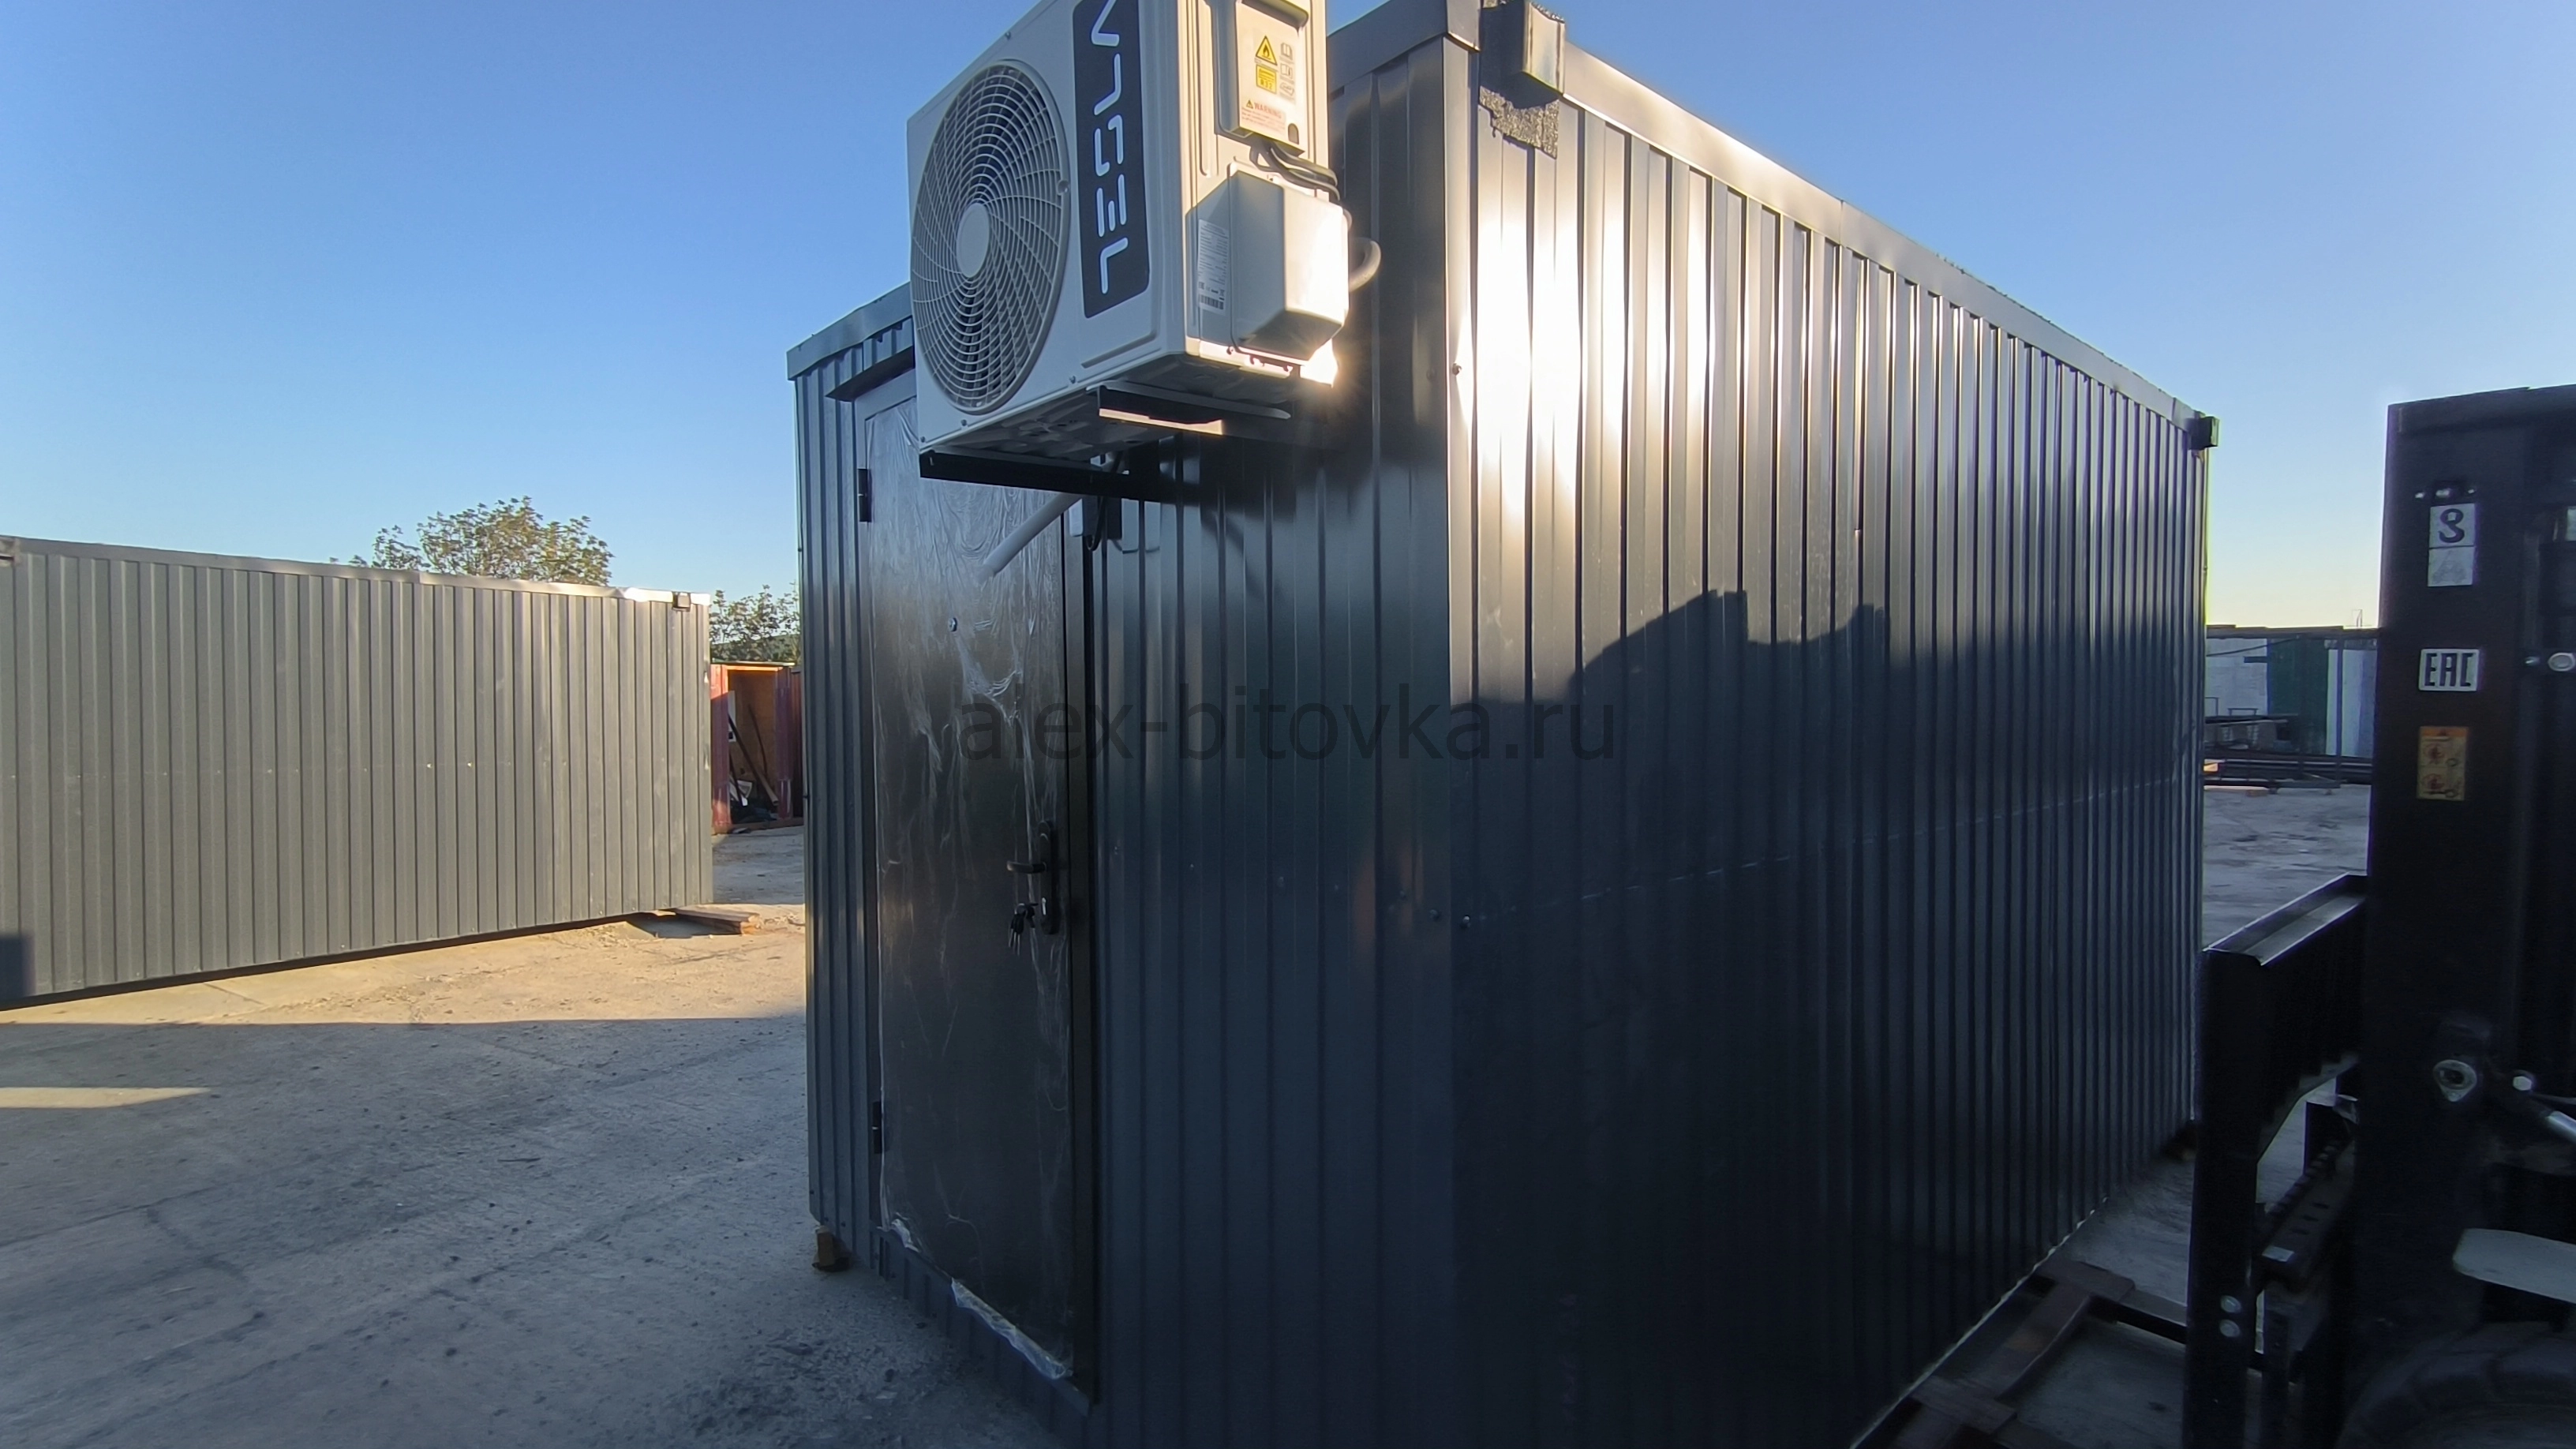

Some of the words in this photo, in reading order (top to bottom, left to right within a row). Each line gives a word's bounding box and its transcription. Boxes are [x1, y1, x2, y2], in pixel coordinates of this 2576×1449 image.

[1253, 102, 1282, 119] WARNING
[1091, 0, 1129, 294] TESLA
[2424, 652, 2475, 687] EAC
